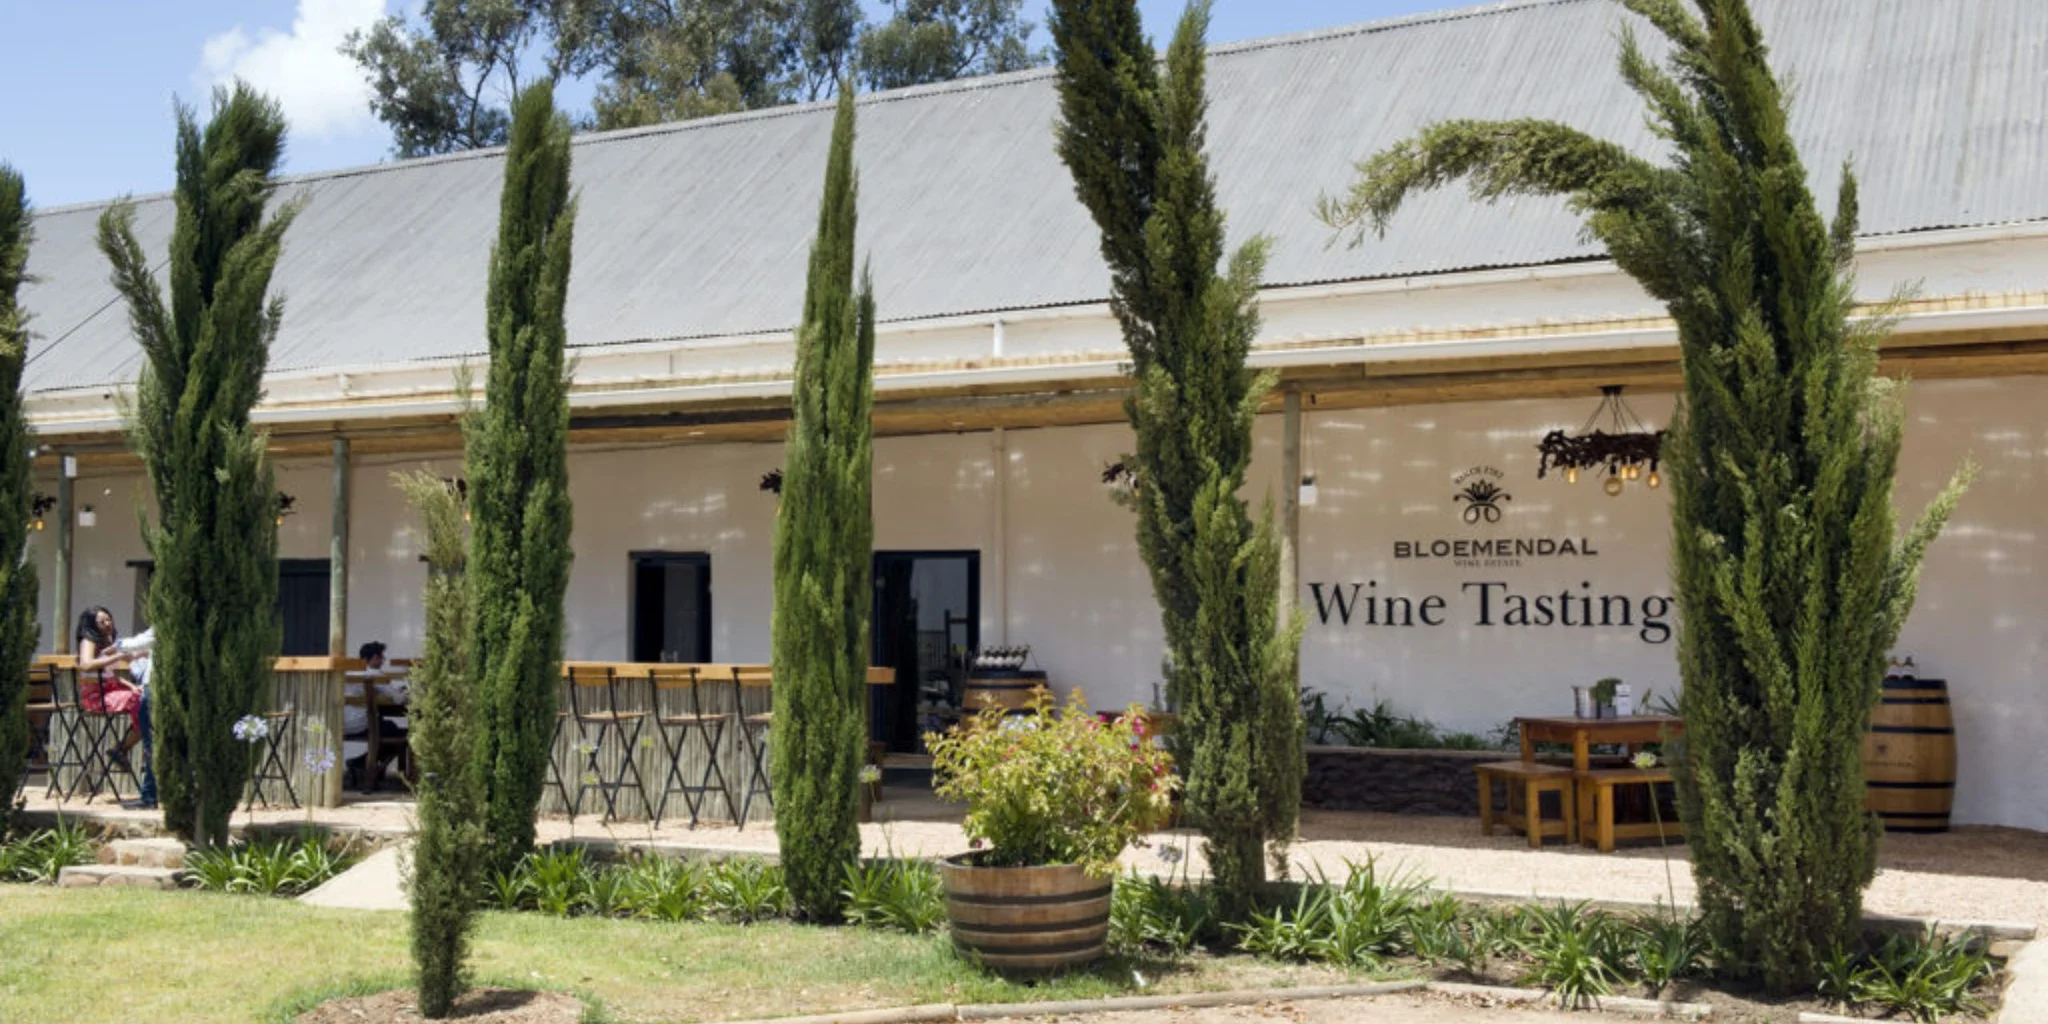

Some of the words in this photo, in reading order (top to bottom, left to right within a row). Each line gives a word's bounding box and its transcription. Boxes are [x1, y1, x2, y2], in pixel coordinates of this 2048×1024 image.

[1394, 537, 1598, 559] BLOEMENDAL
[1309, 579, 1447, 627] Wine
[1461, 580, 1675, 644] Tasting
